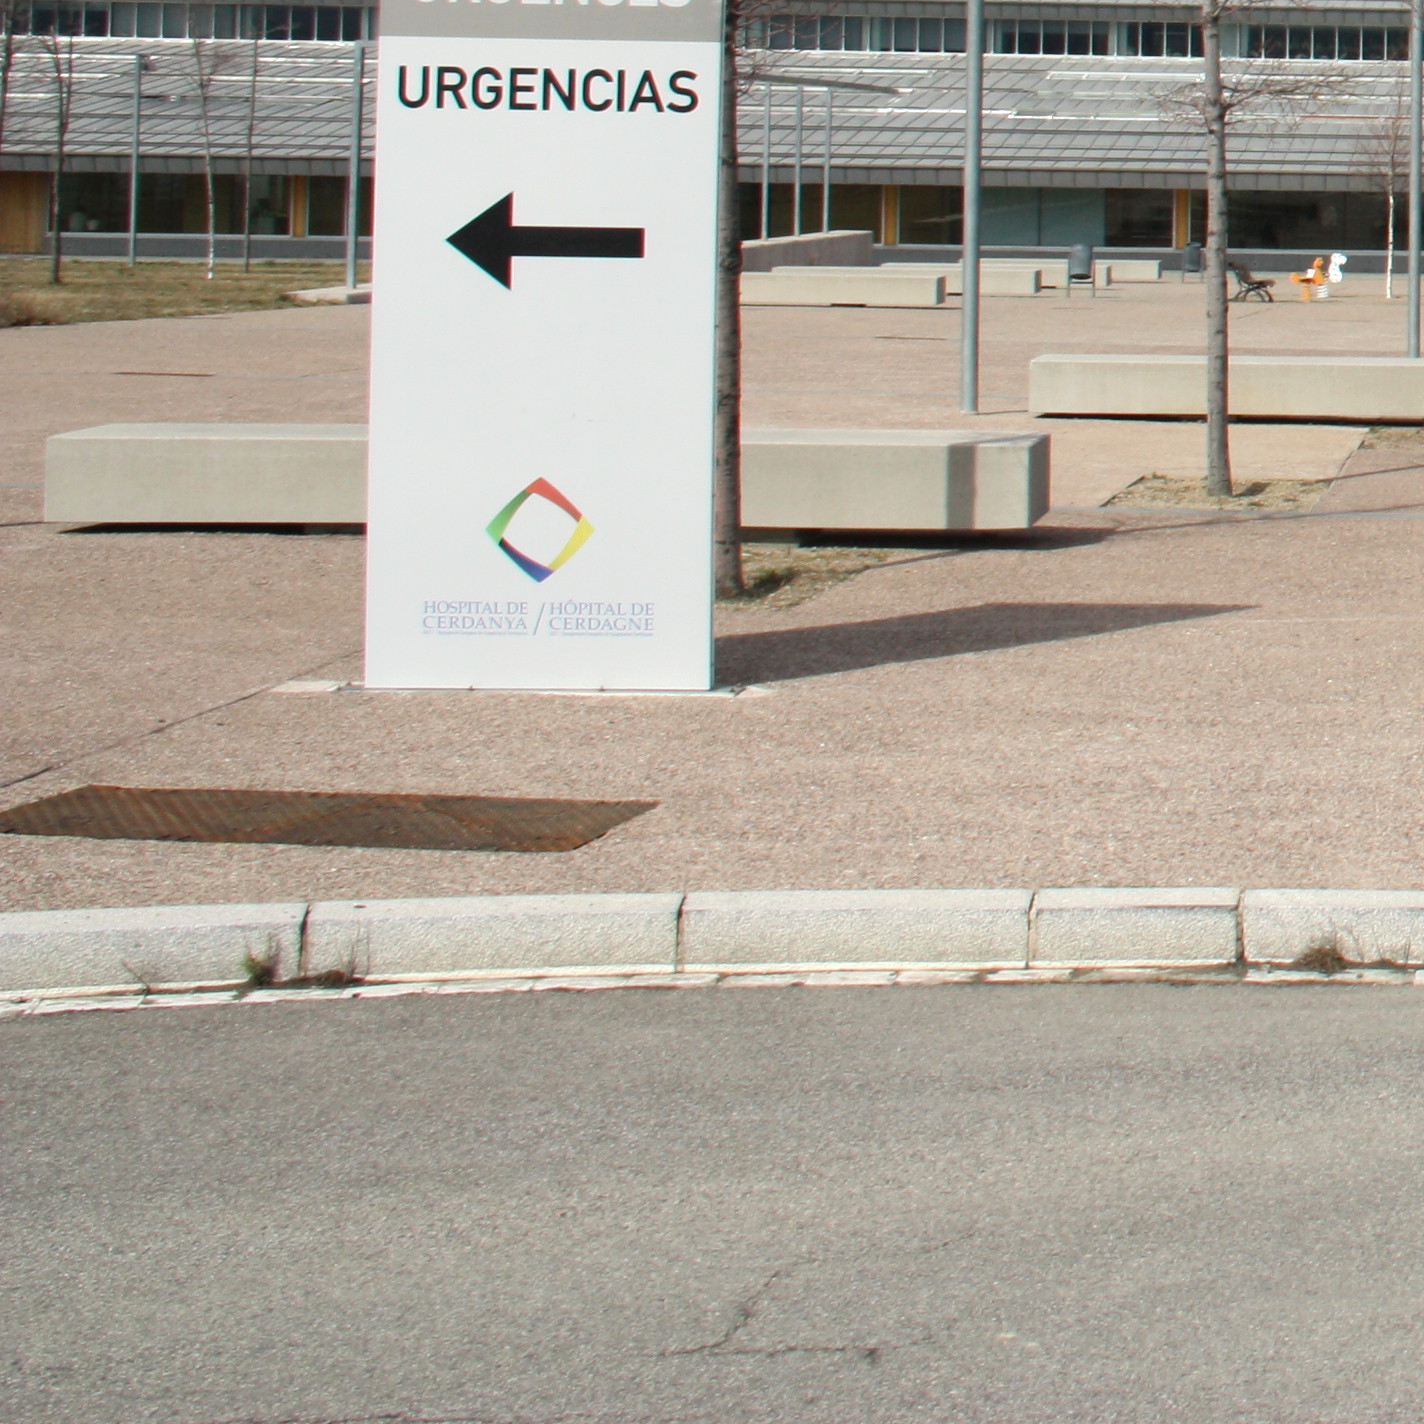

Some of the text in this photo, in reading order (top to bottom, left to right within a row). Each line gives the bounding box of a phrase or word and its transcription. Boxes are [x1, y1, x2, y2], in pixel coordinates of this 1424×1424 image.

[398, 65, 699, 113] URGENCIAS
[424, 600, 528, 615] HOSPITAL DE
[550, 599, 655, 616] HÔPITAL DE
[423, 615, 527, 629] CERDANYA
[549, 617, 655, 631] CERDAGNE
